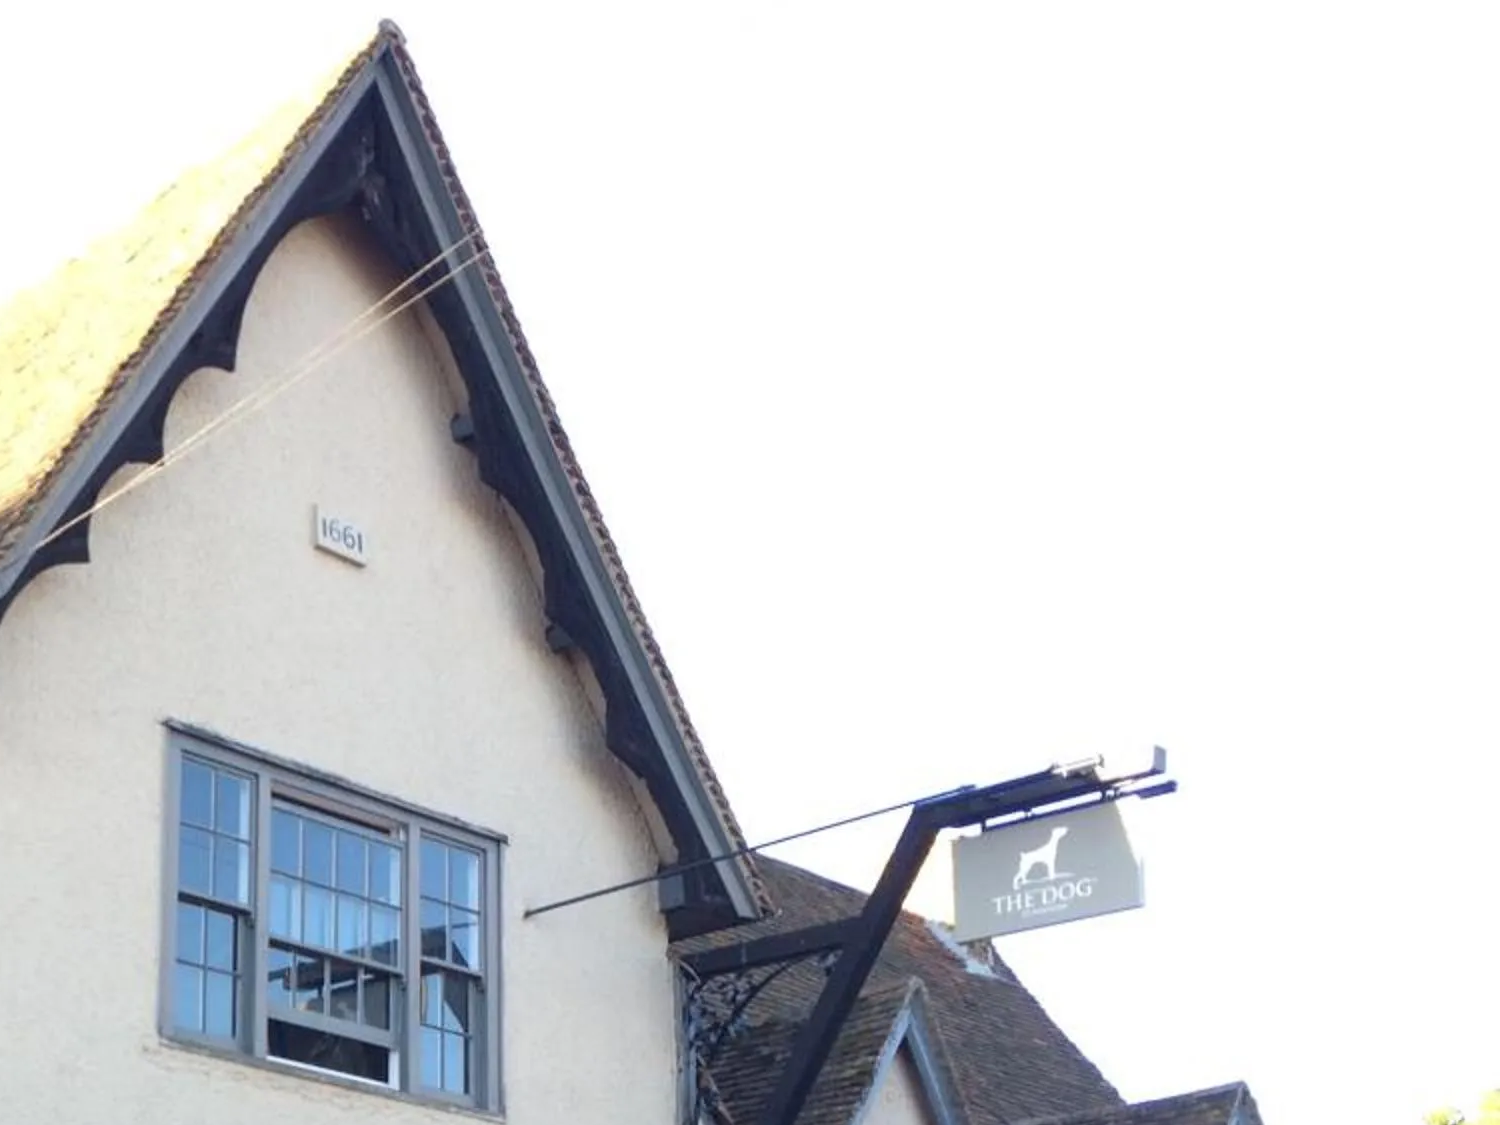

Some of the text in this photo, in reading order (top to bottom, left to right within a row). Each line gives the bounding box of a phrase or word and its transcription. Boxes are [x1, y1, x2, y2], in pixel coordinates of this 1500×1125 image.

[322, 517, 363, 554] 1661
[991, 889, 1036, 914] THE
[1041, 877, 1092, 905] DOG
